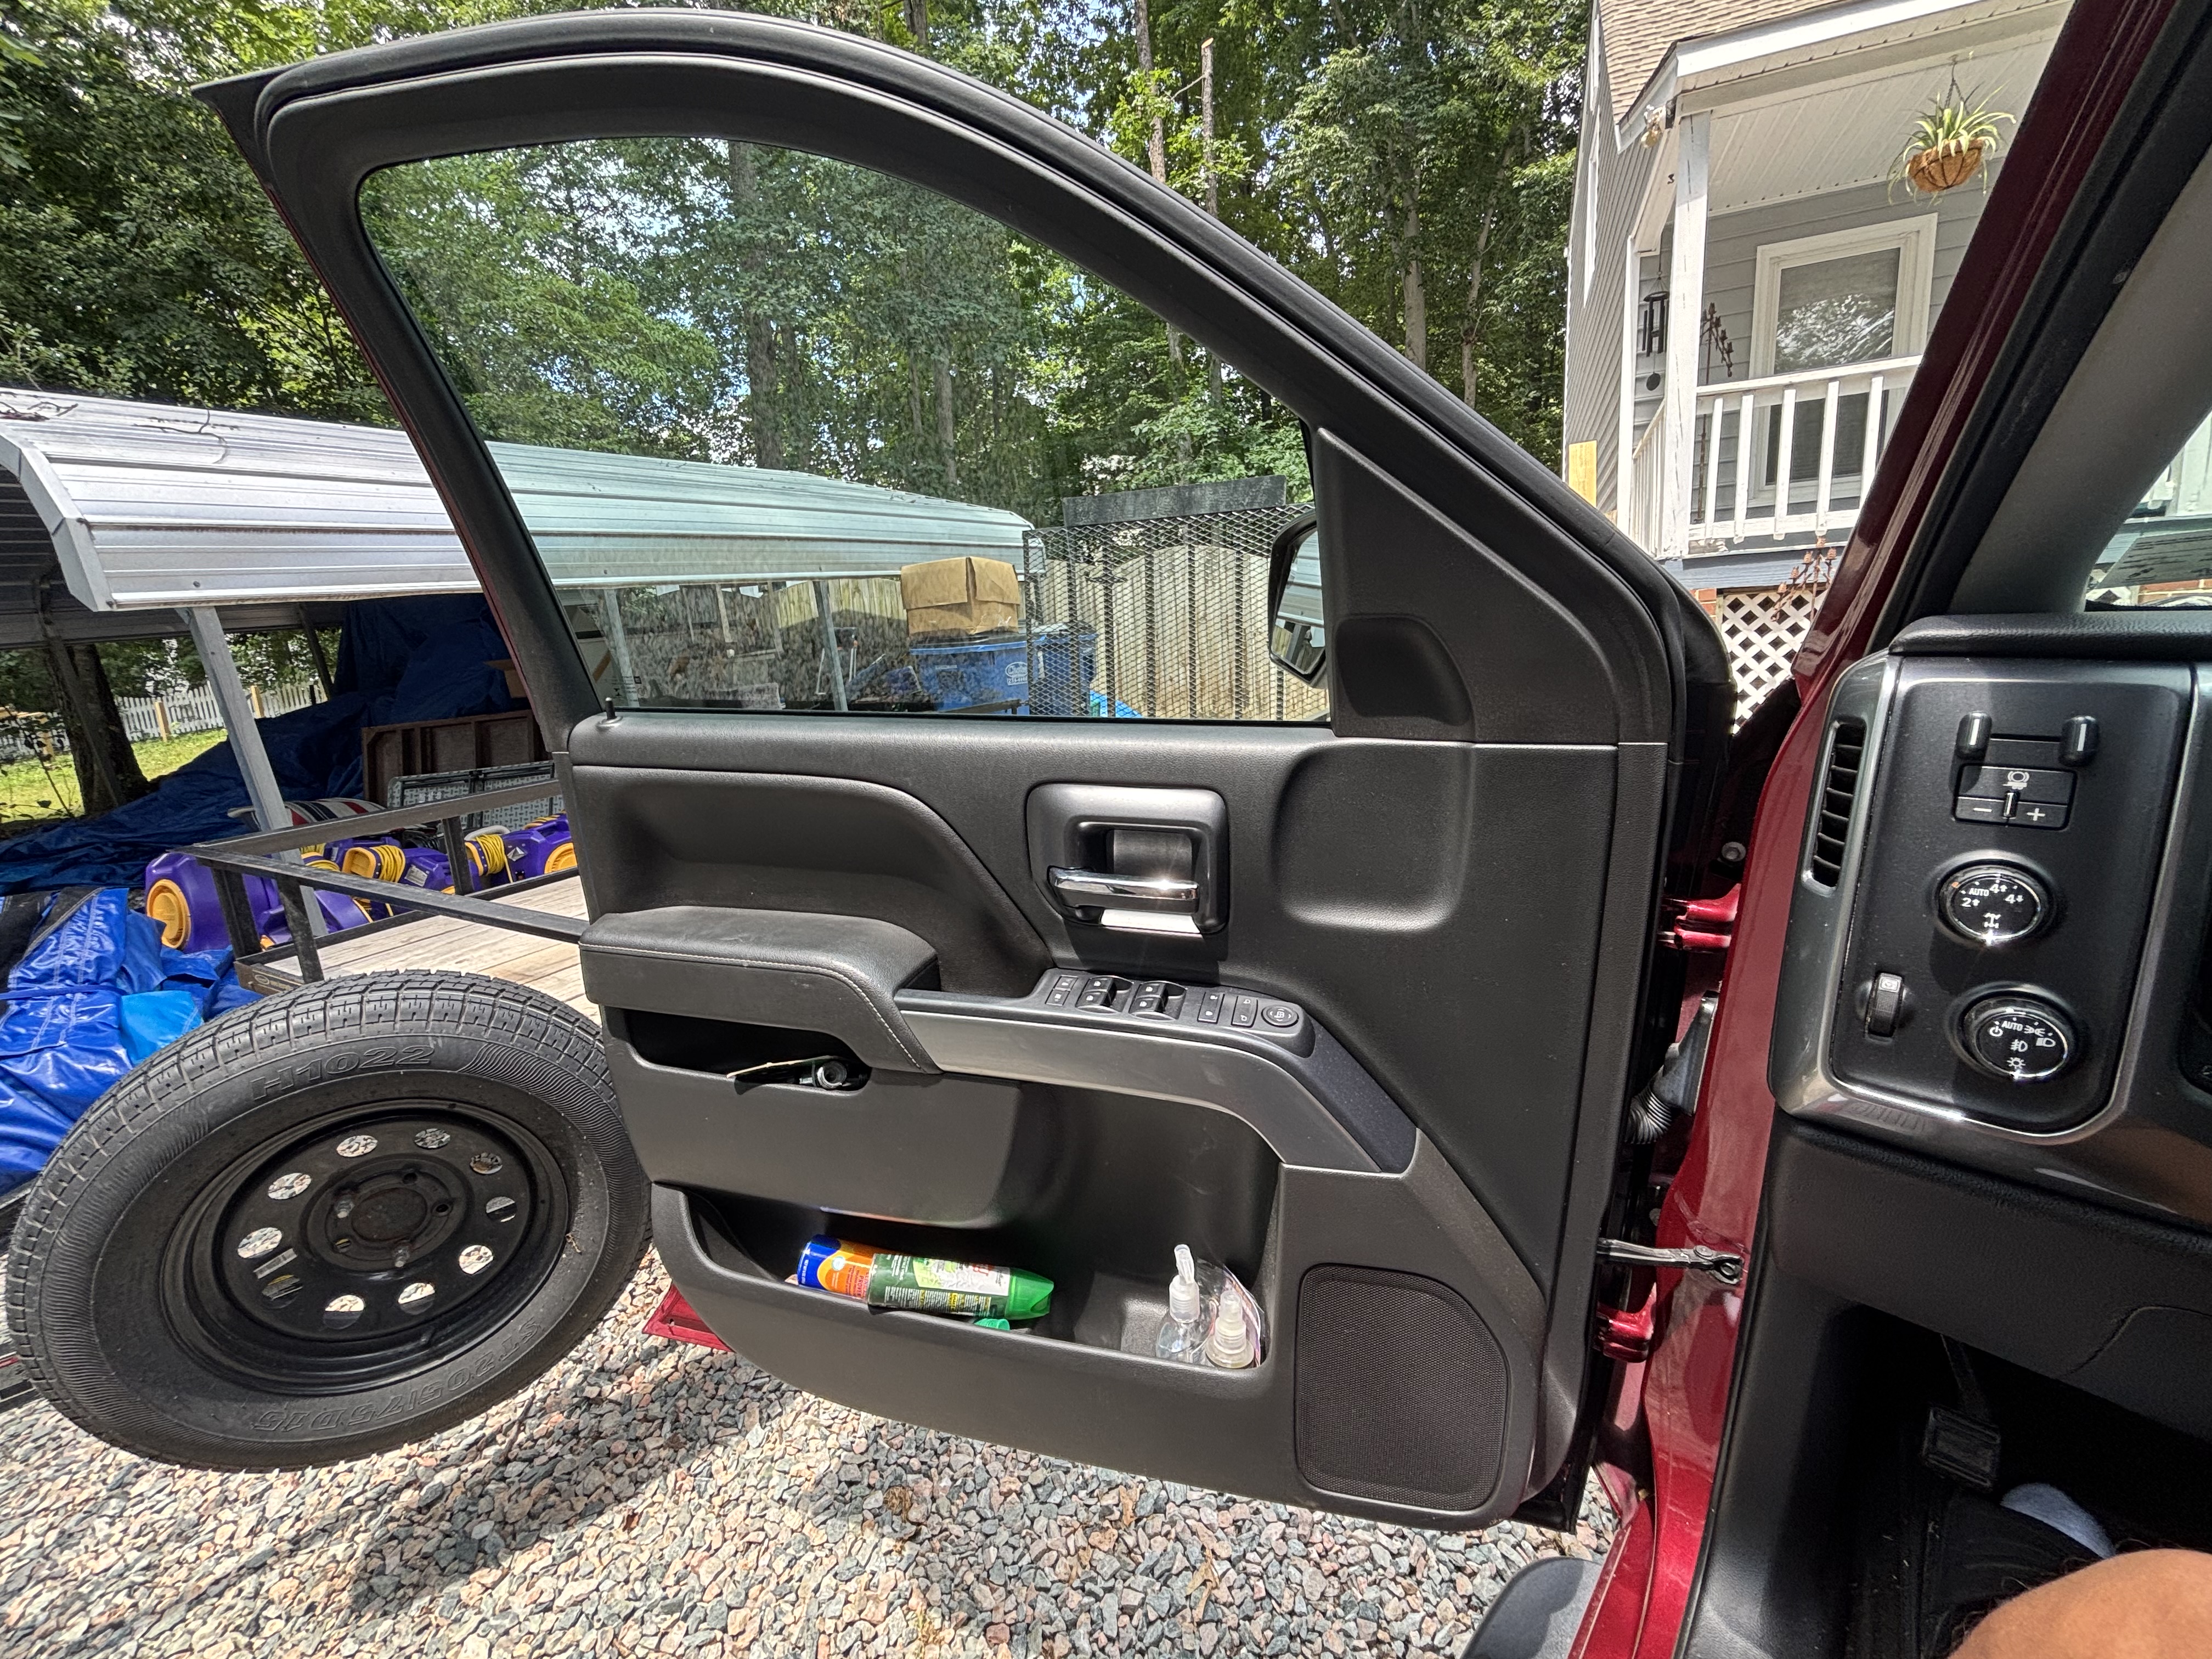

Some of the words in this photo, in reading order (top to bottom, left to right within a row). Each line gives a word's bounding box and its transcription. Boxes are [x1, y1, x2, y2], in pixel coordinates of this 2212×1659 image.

[1968, 888, 1990, 897] AUTO
[2001, 1020, 2023, 1031] AUTO
[250, 1045, 435, 1101] H1022
